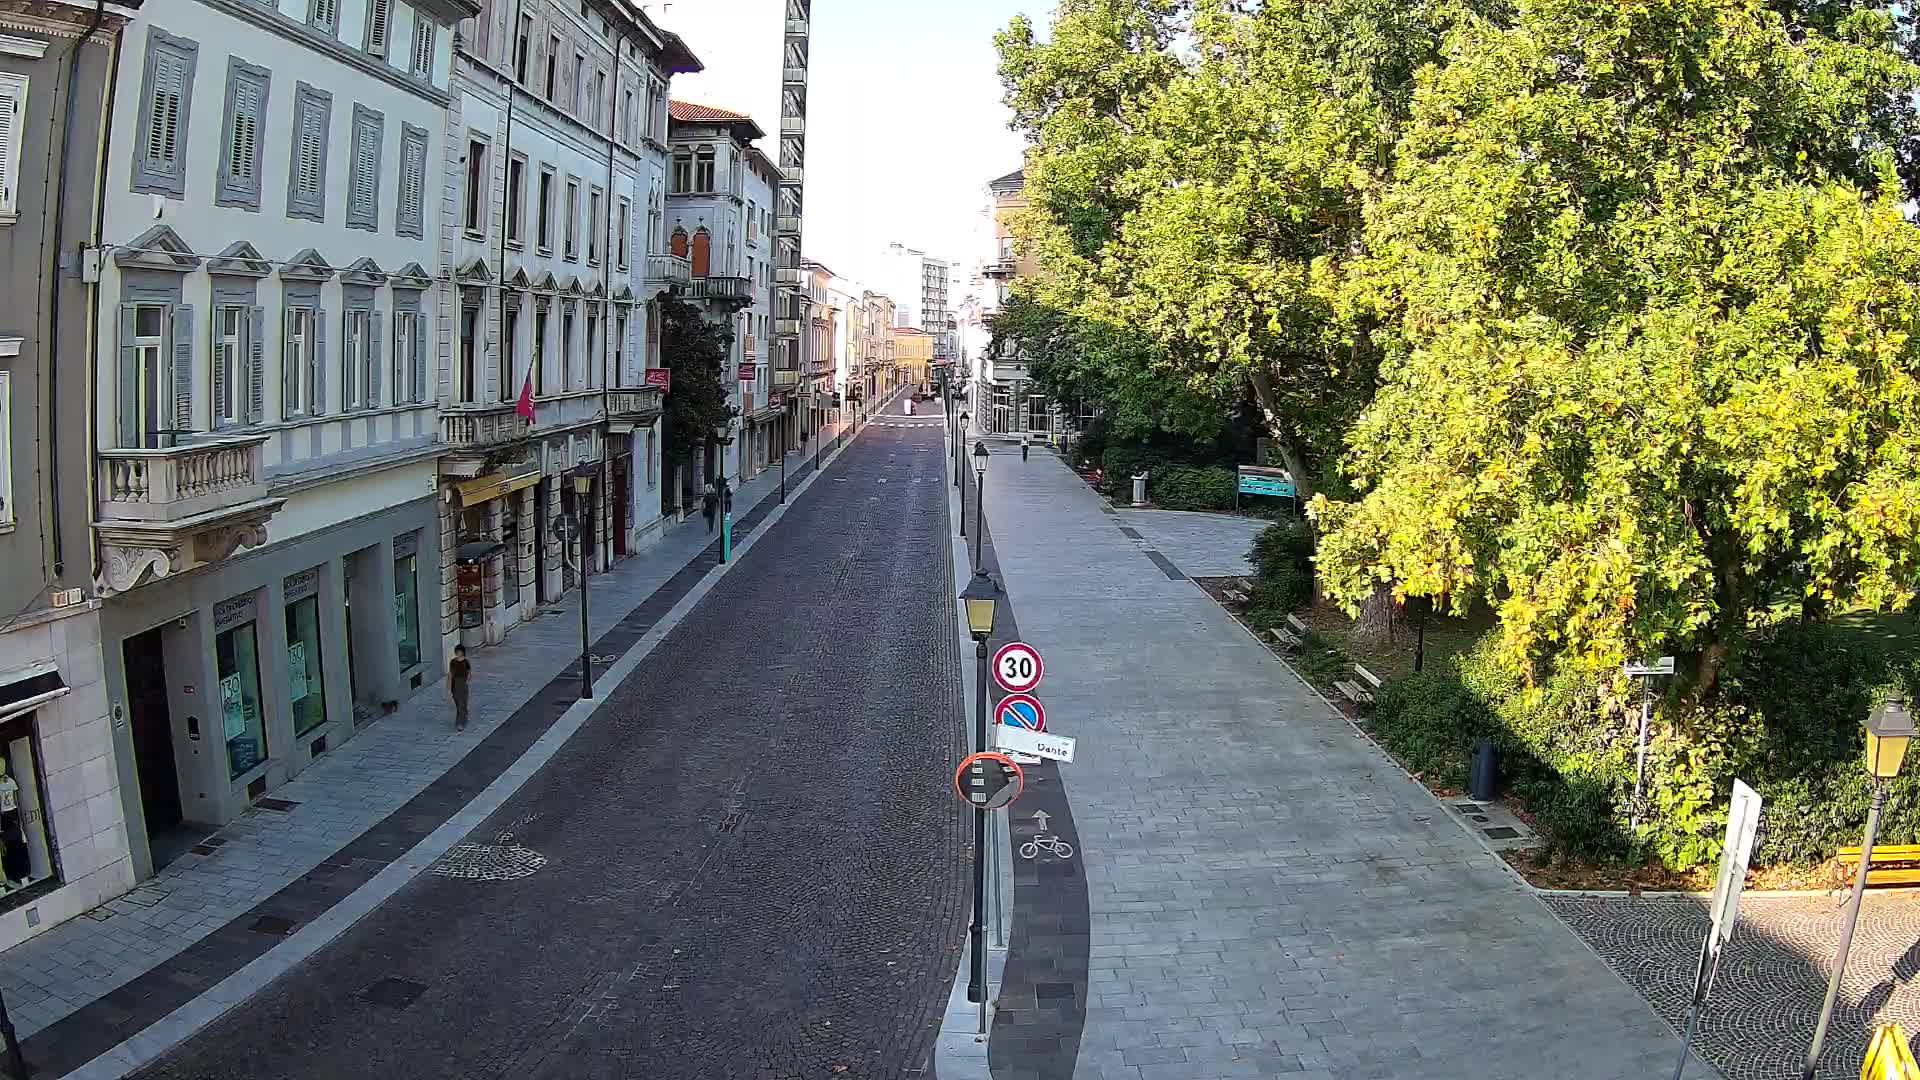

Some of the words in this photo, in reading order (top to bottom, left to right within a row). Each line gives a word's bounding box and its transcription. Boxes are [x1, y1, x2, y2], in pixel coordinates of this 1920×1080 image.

[1005, 657, 1032, 678] 30
[222, 677, 239, 698] 130
[1038, 743, 1068, 757] Dante
